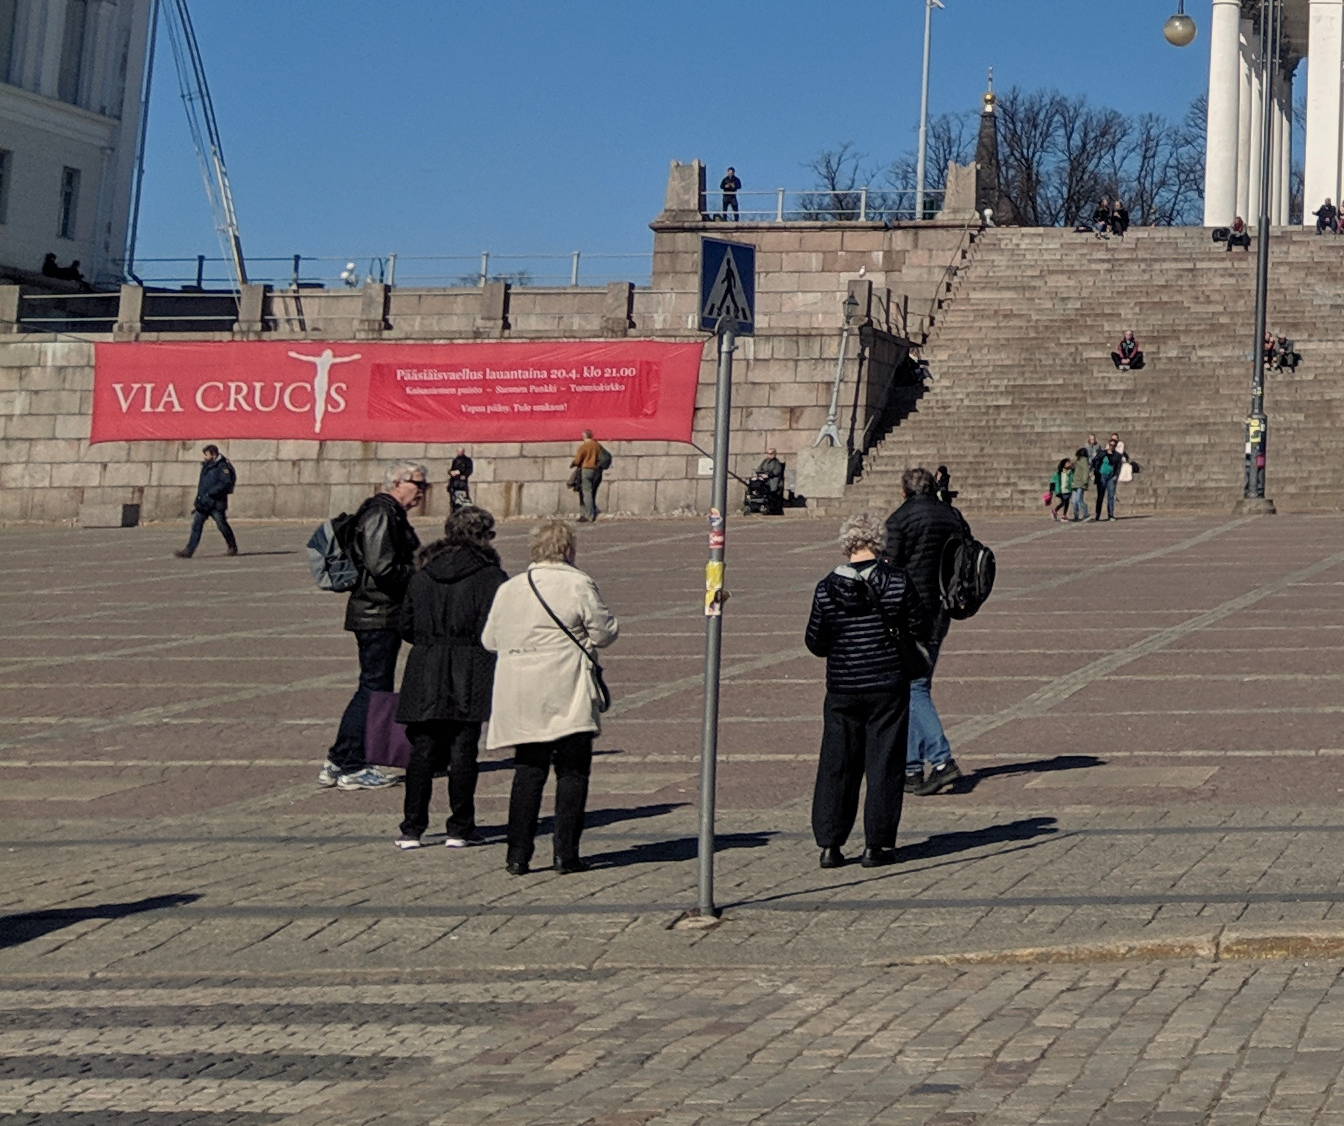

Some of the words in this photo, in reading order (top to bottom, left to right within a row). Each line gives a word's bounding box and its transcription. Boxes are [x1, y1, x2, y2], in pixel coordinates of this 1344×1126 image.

[396, 368, 483, 381] Pääsiäisvaellus
[485, 368, 547, 380] lauantaina
[550, 369, 580, 381] 20.4.
[583, 366, 602, 378] klo
[604, 367, 637, 377] 21.00
[112, 382, 184, 413] VIA
